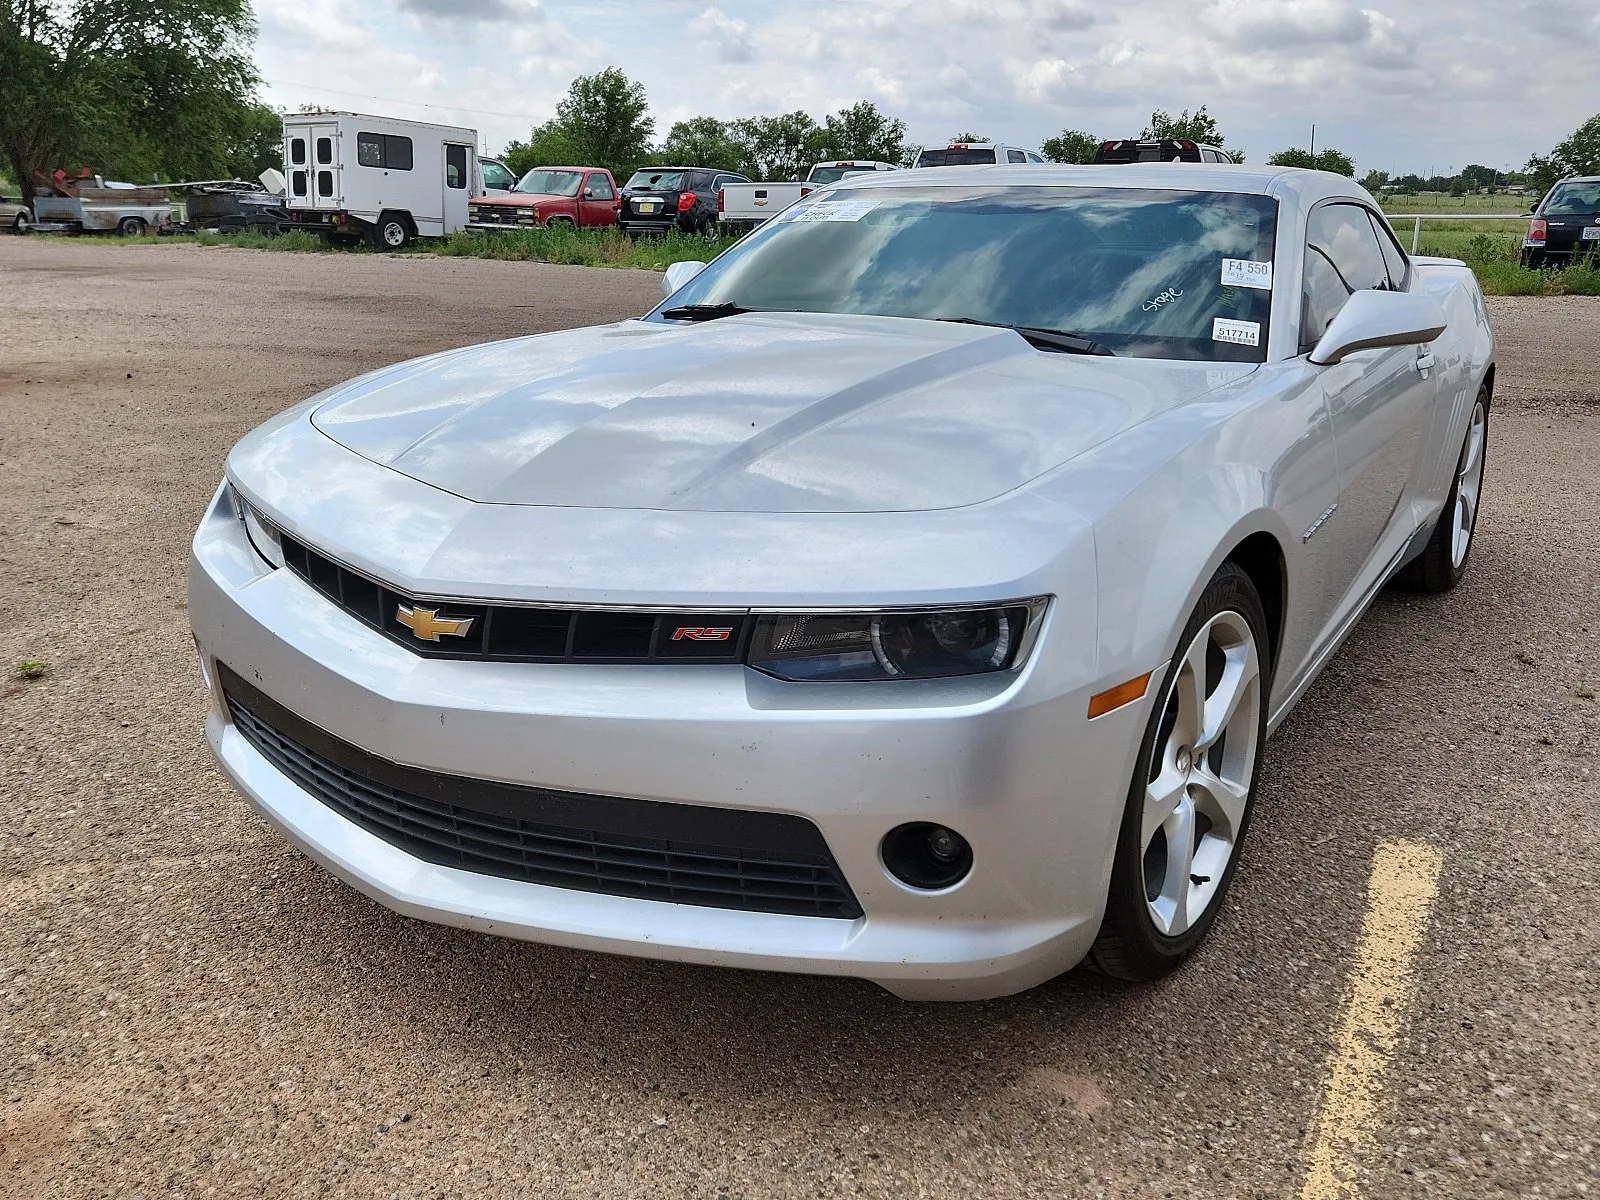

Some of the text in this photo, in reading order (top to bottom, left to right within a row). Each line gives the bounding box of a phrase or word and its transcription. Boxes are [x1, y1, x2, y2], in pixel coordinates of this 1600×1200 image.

[1229, 261, 1268, 275] F4 550
[1218, 327, 1256, 339] 517714
[670, 627, 733, 641] RS
